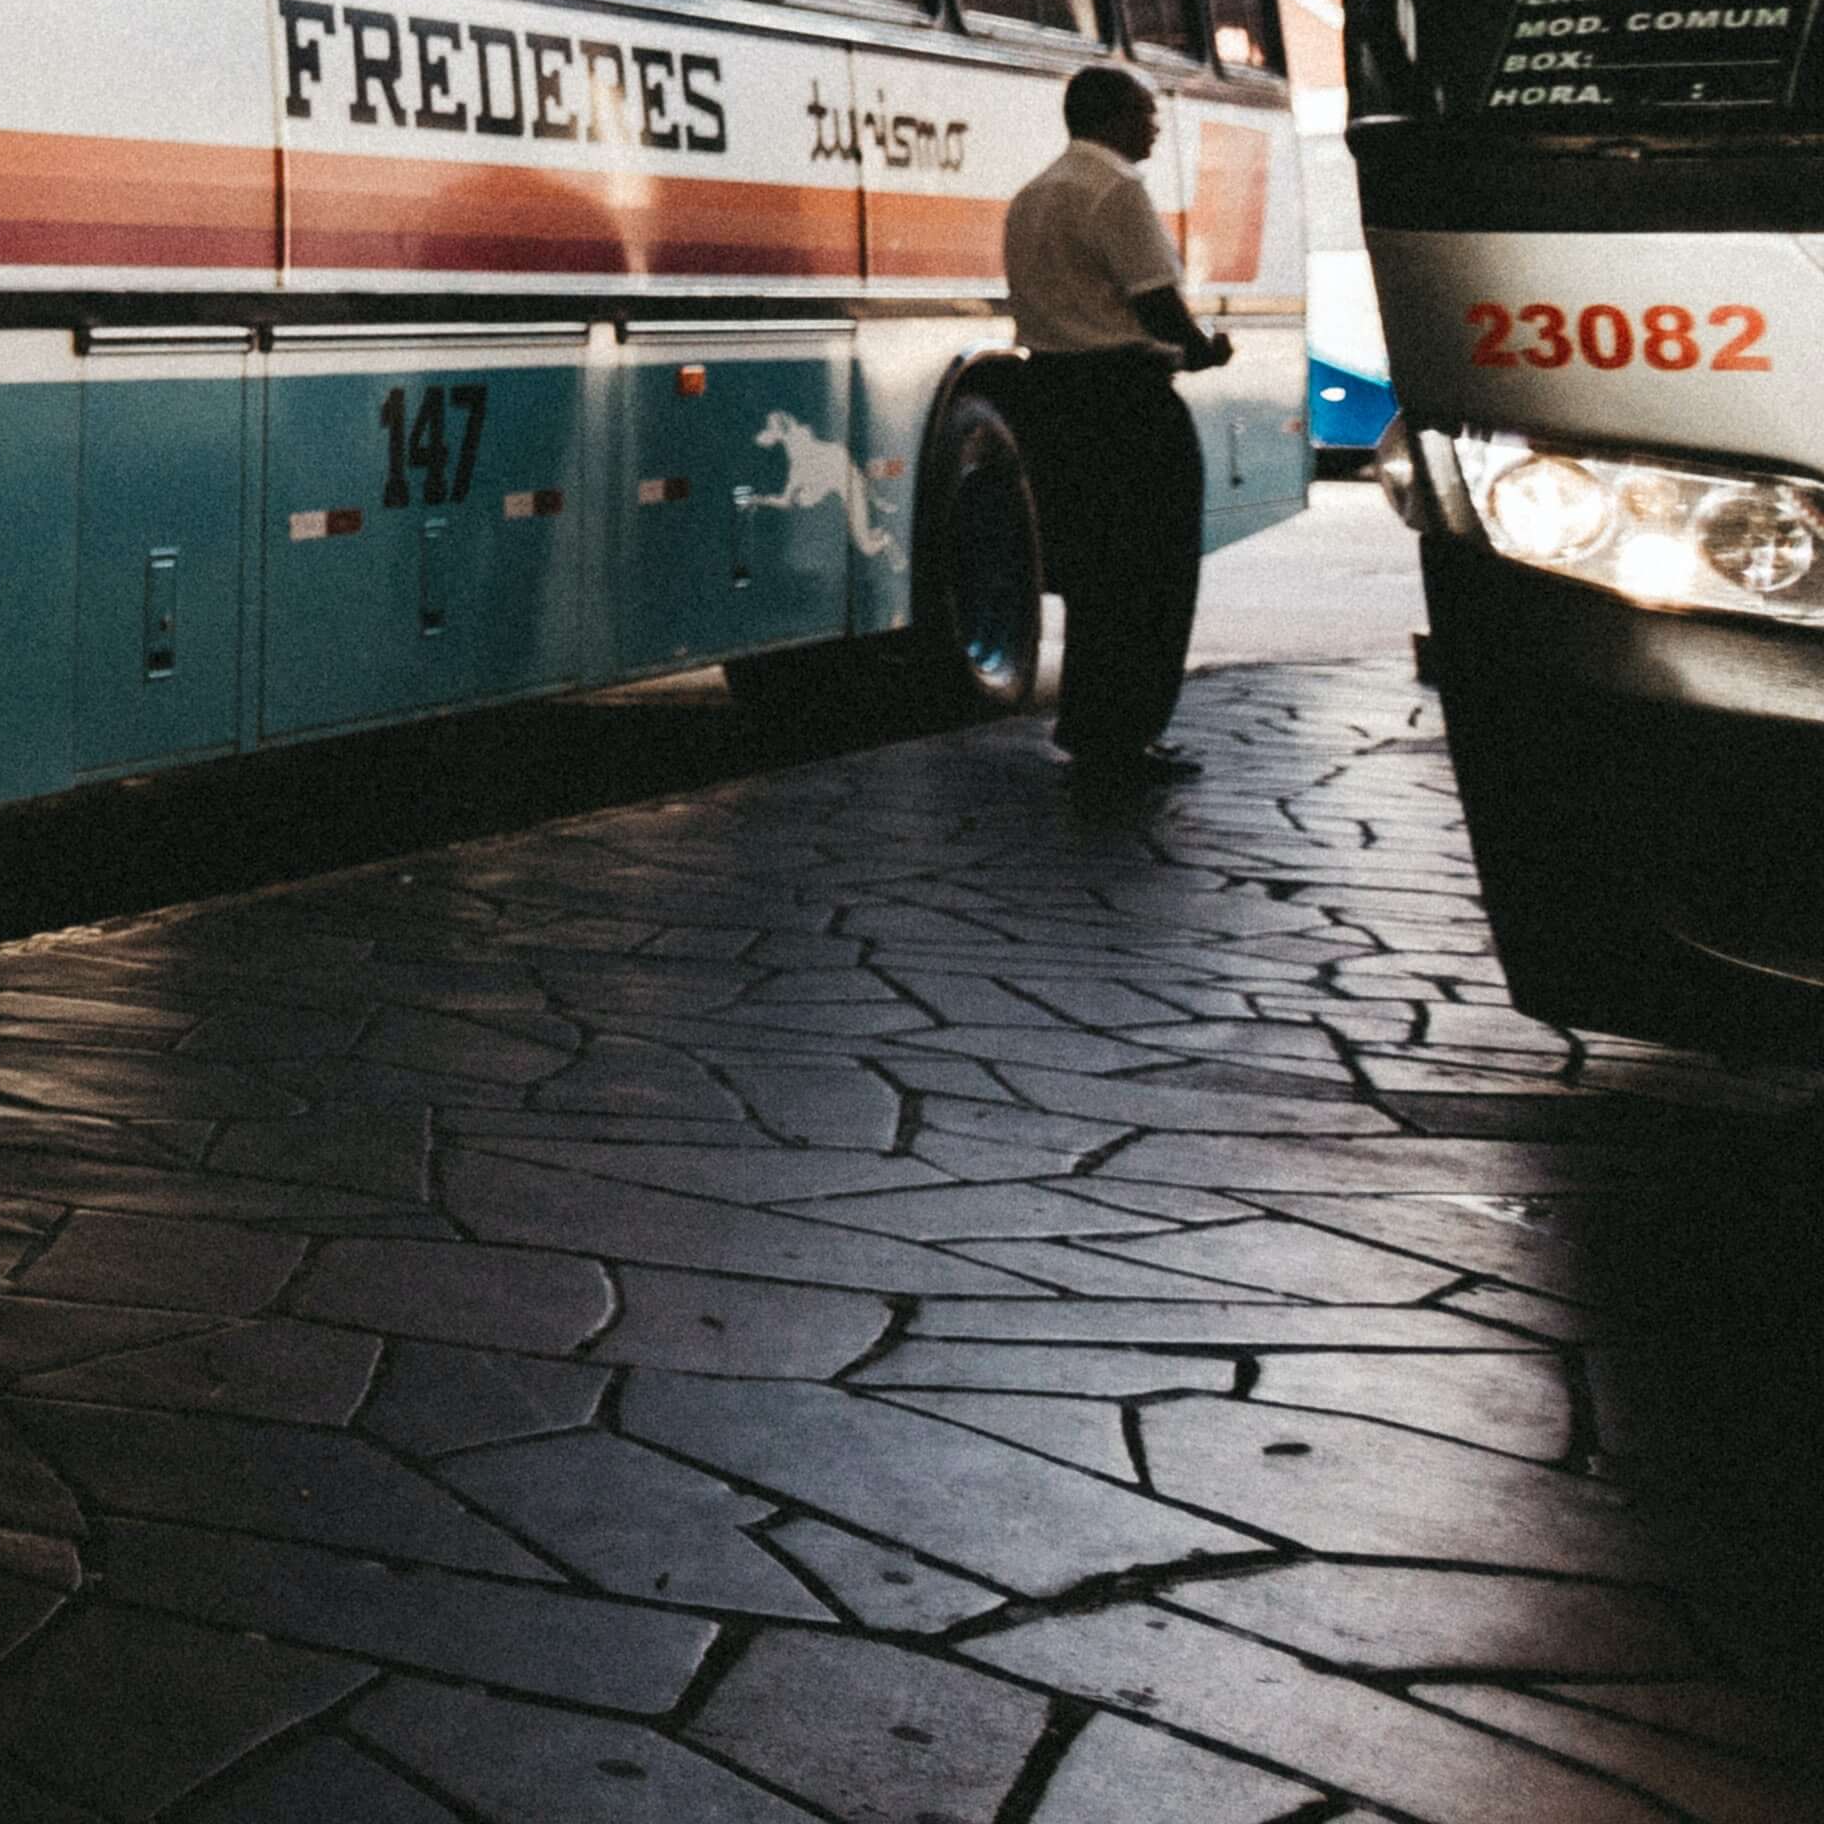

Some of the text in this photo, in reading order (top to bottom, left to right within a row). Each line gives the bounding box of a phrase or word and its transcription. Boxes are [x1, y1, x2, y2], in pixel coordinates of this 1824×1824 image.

[1627, 7, 1789, 31] COMUM
[807, 80, 968, 171] turismo
[1464, 302, 1772, 372] 23082
[381, 384, 488, 508] 147
